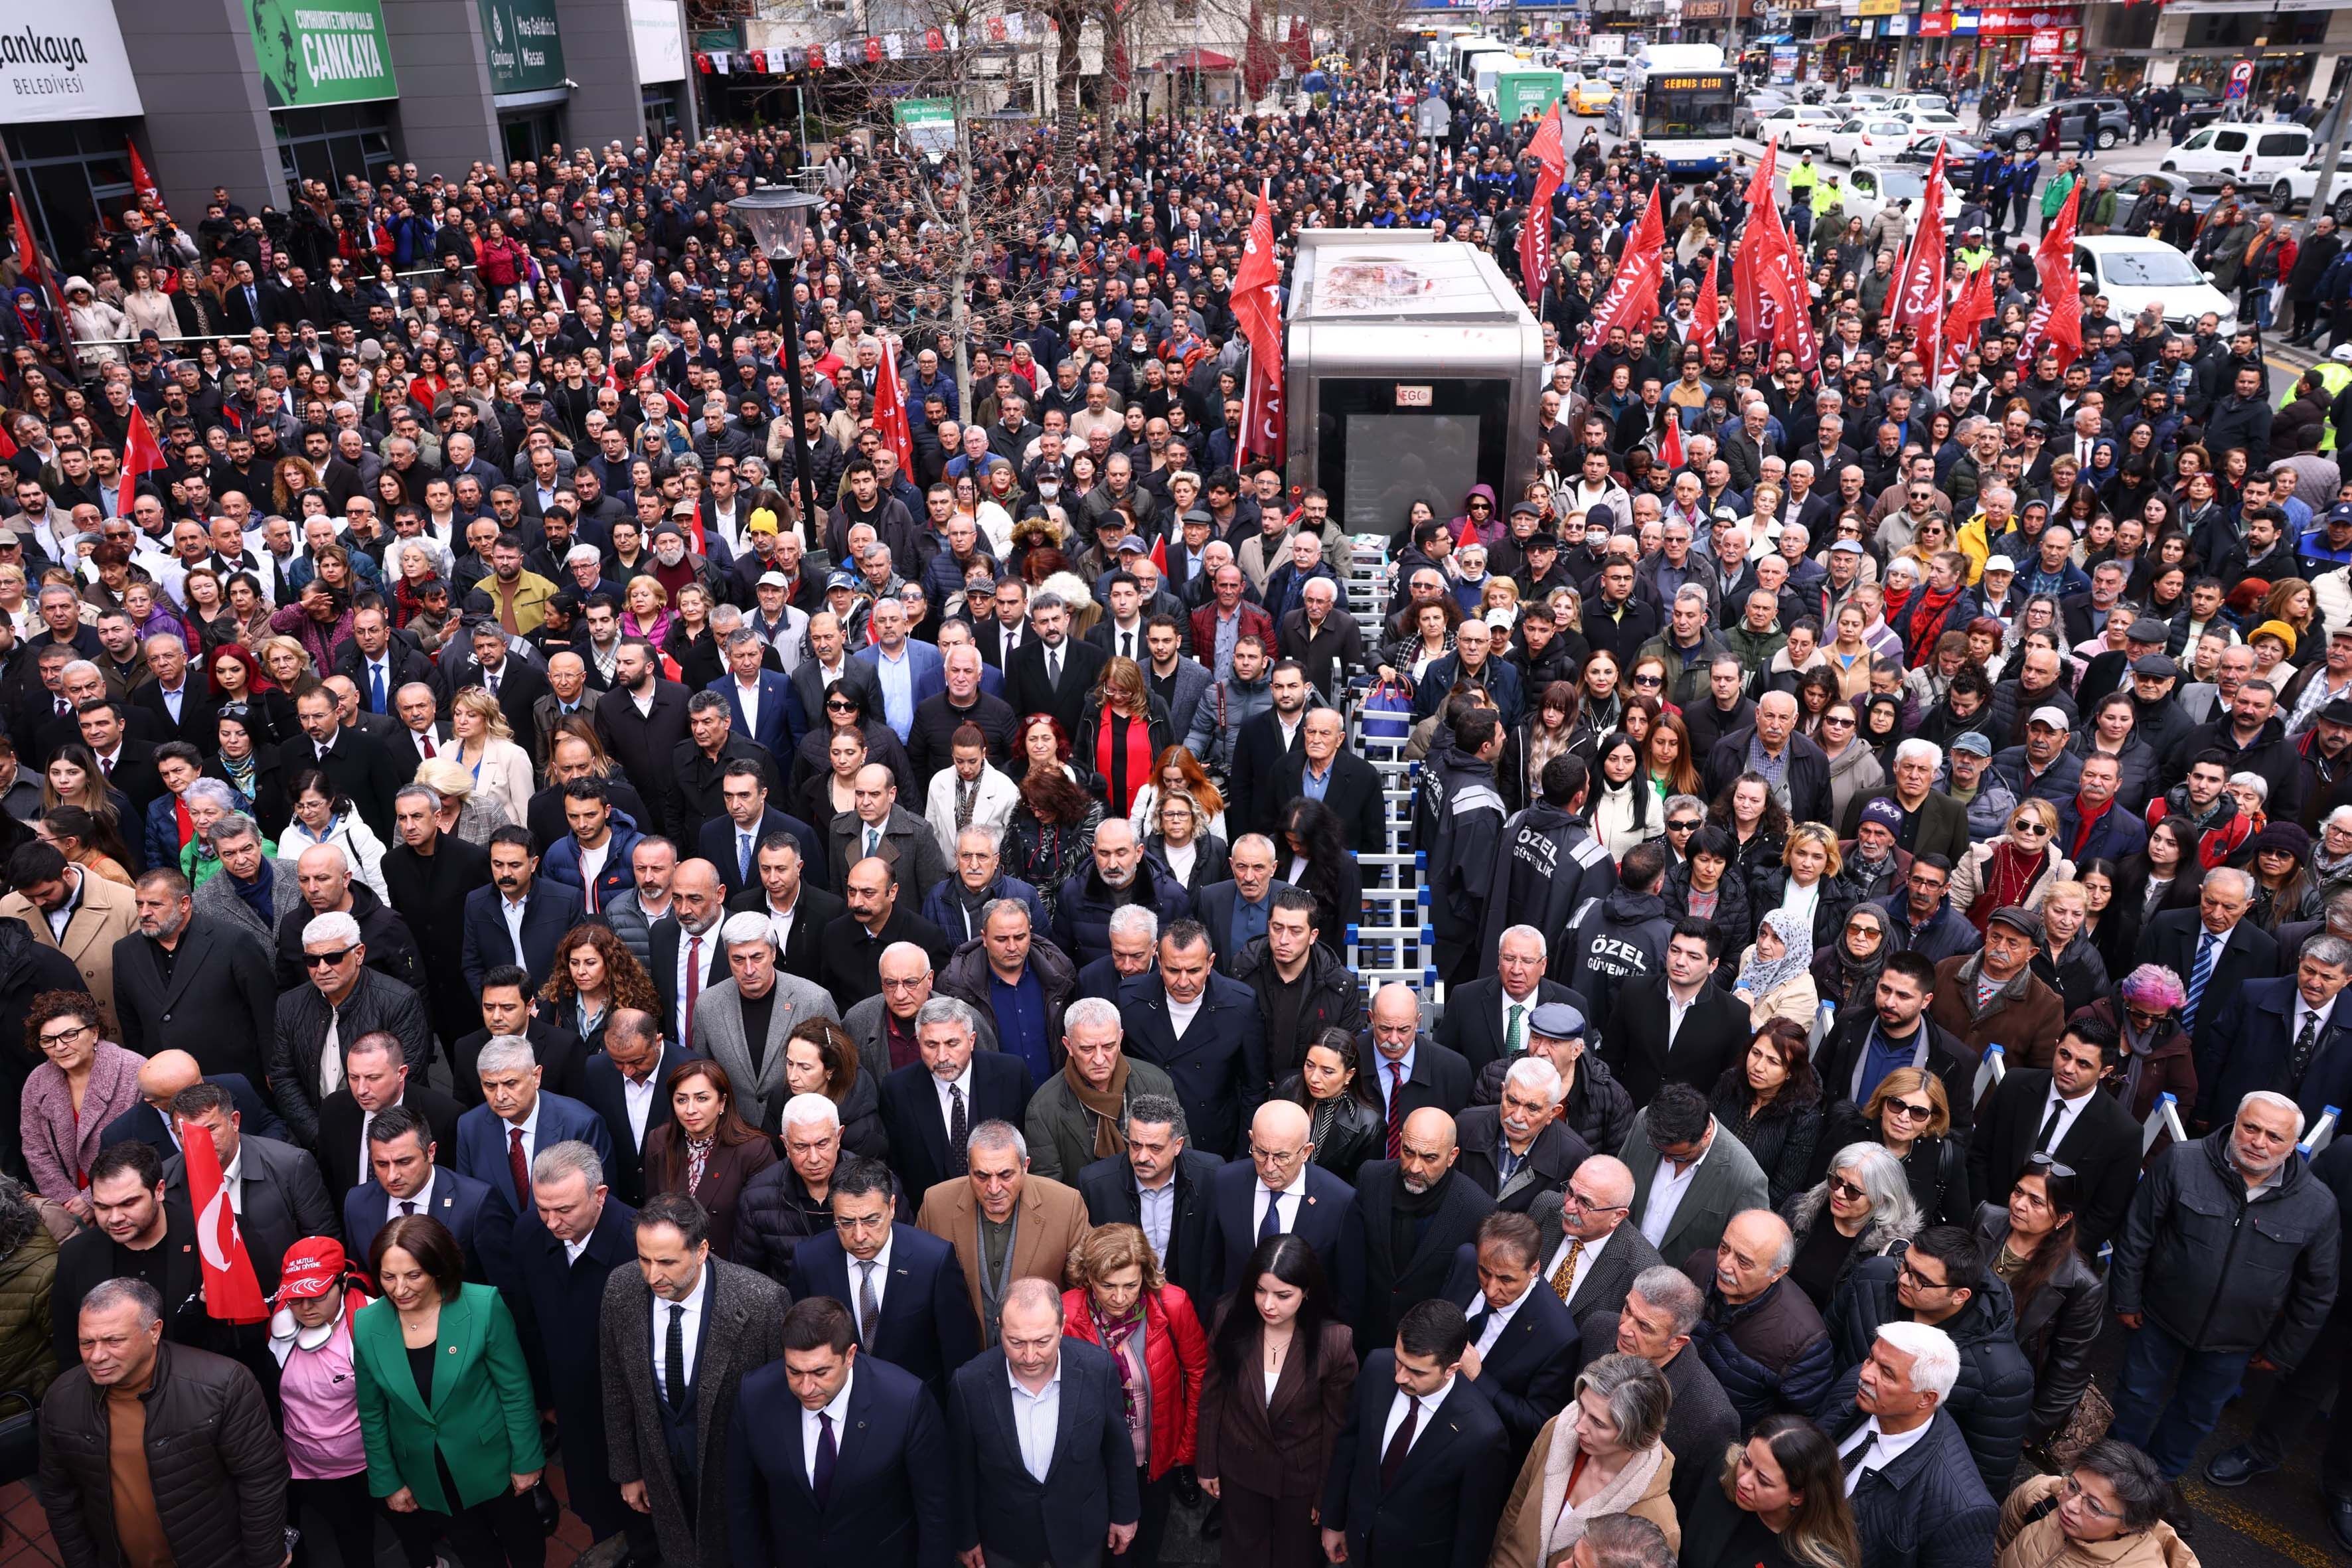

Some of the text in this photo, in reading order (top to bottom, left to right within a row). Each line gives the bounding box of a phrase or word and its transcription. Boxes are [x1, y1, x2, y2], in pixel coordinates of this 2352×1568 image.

[516, 16, 556, 38] Hoş Geldiniz
[301, 33, 384, 88] ÇANKAYA
[491, 49, 514, 68] Çankaya
[522, 47, 545, 66] Masası
[13, 74, 84, 94] BELEDİYESİ
[1518, 825, 1557, 866] ÖZEL
[1591, 934, 1646, 971] ÖZEL
